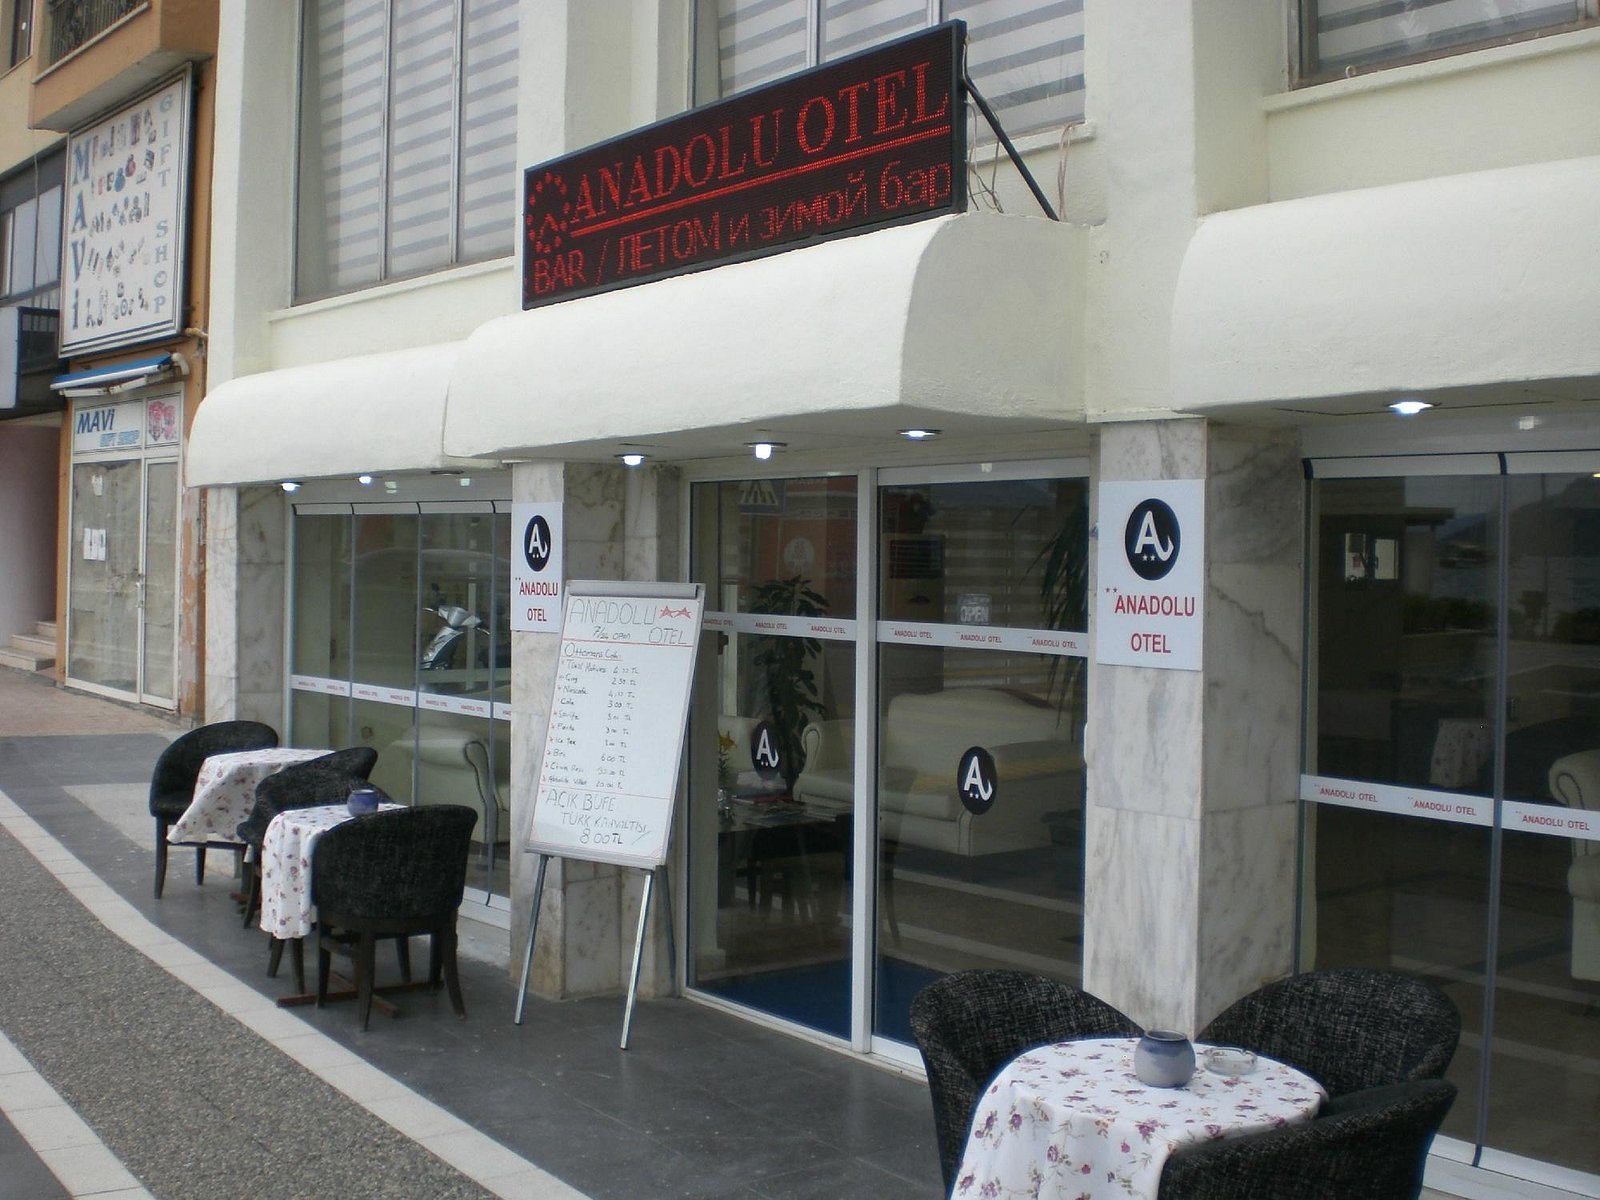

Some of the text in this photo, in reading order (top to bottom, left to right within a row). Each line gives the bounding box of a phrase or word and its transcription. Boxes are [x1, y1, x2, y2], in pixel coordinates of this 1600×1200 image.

[570, 62, 949, 224] ANADOLU OTEL
[154, 94, 174, 315] GIFT SHOP
[534, 249, 586, 294] BAR
[519, 581, 558, 597] ANADOLU
[570, 598, 657, 625] ANADOLU
[960, 605, 989, 622] OPEN
[1115, 595, 1195, 617] ANADOLU
[527, 608, 547, 622] OTEL
[648, 627, 687, 644] OTEL
[894, 629, 933, 639] ANADOLU OTEL
[960, 633, 1002, 643] ANADOLU OTEL
[1031, 638, 1078, 649] ANADOLU OTEL
[1131, 633, 1171, 653] OTEL
[1319, 787, 1378, 803] ANADOLU OTEL
[1414, 799, 1477, 816] ANADOLU OTEL
[1522, 814, 1590, 831] ANADOLU OTEL
